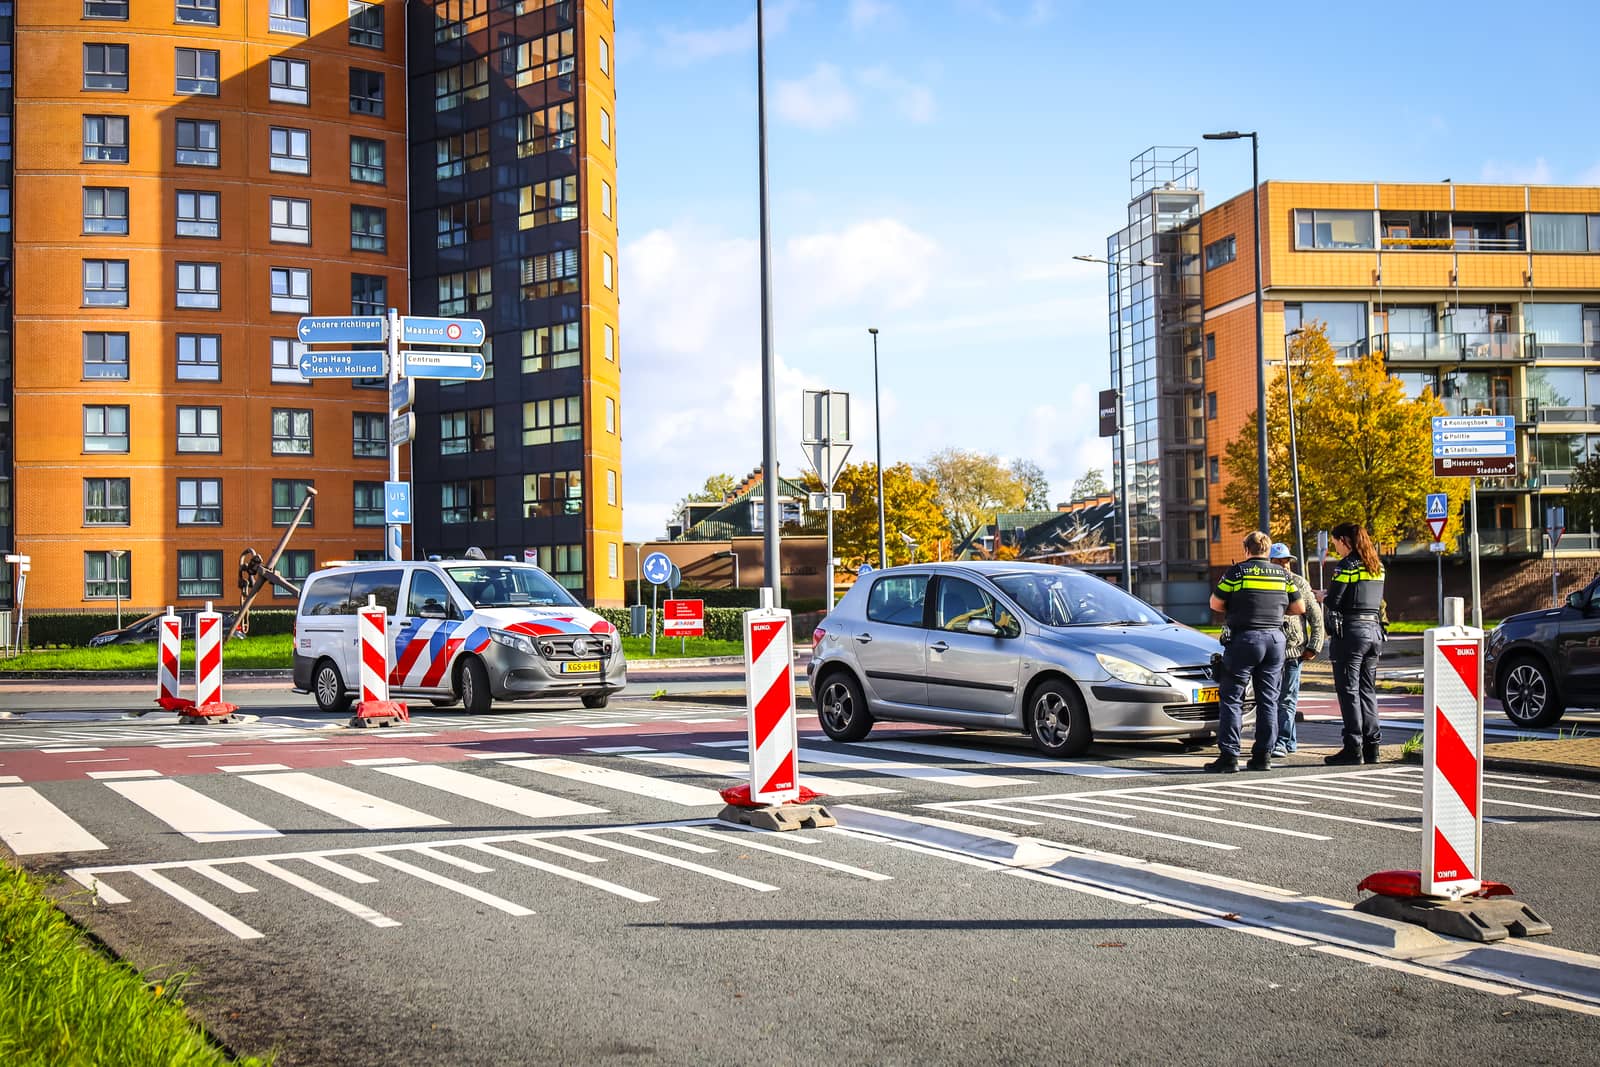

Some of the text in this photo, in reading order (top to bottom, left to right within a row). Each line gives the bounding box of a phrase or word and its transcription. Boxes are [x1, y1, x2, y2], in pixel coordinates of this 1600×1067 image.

[341, 320, 380, 329] richtingen
[406, 326, 444, 335] Maasland
[312, 355, 352, 364] Den Haag
[408, 355, 441, 363] Centrum
[345, 365, 377, 373] Holland
